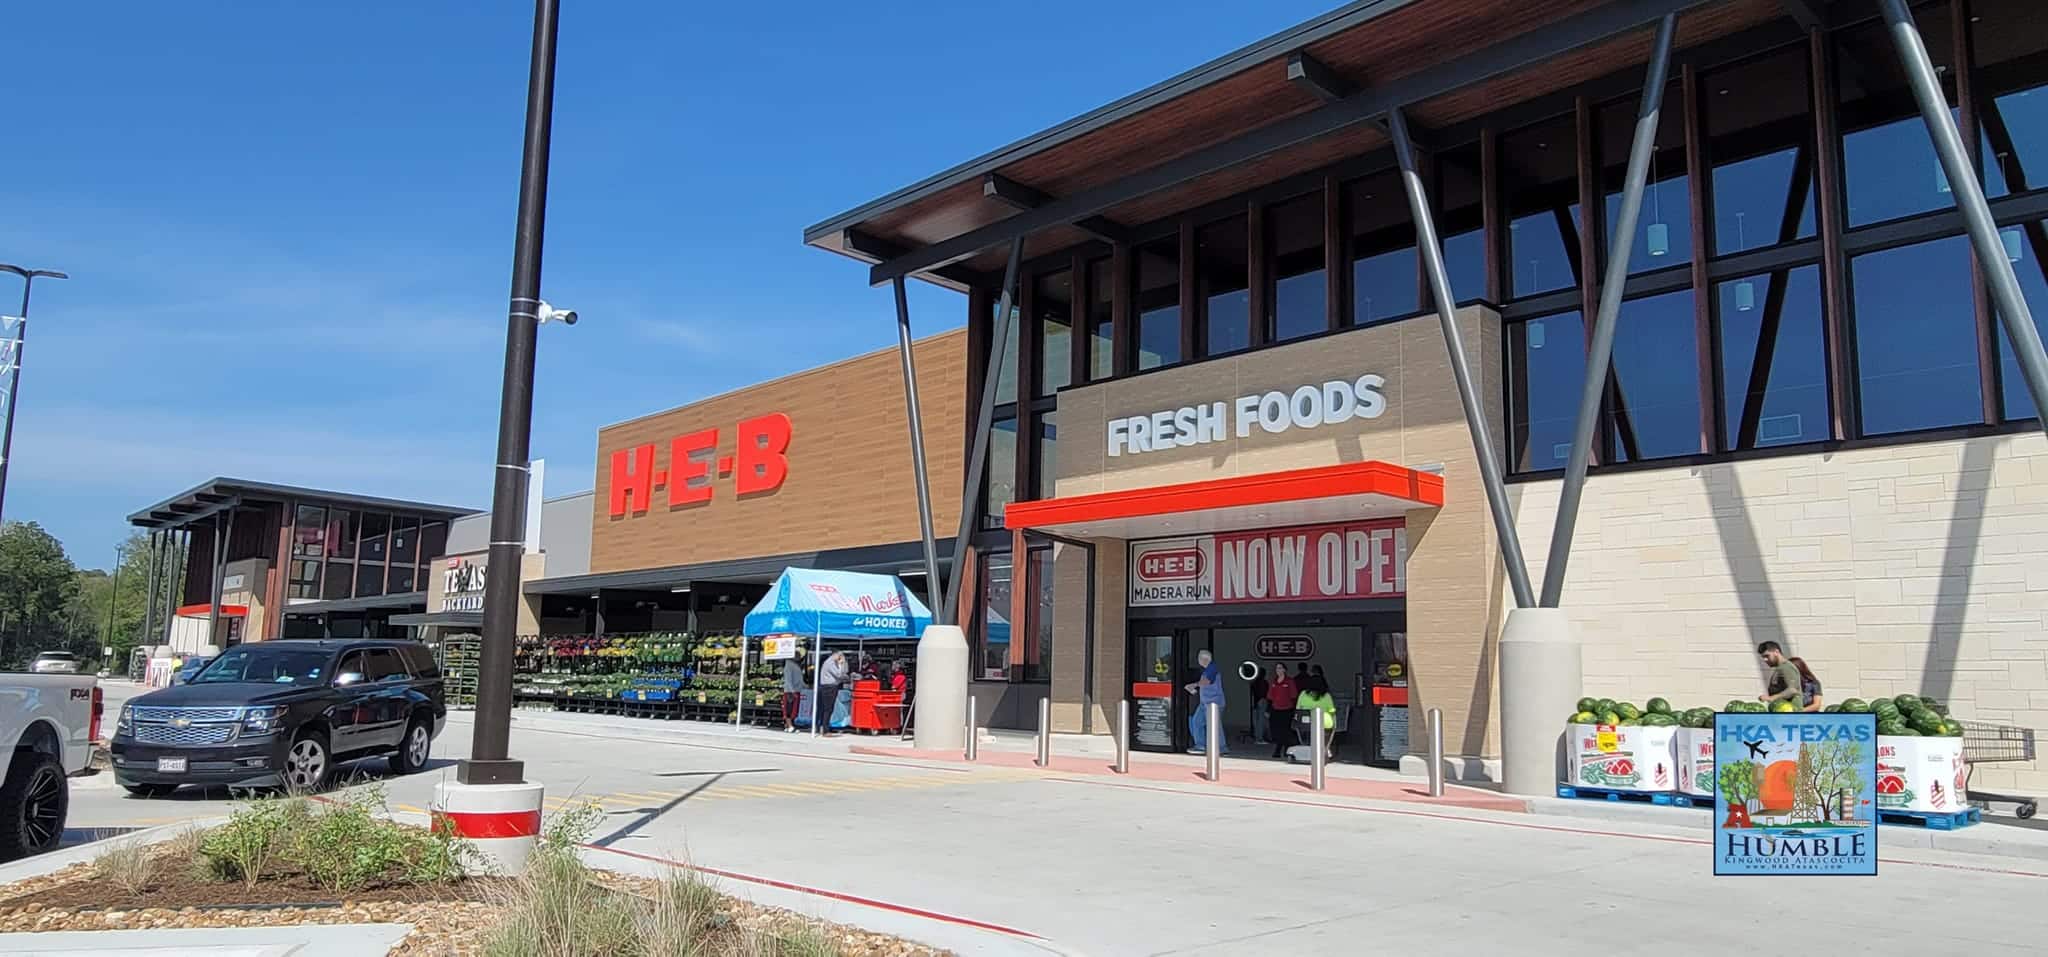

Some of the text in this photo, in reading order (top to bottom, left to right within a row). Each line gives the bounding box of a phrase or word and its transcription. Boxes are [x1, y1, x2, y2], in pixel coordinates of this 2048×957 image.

[1108, 374, 1386, 457] FRESH FOODS
[1222, 535, 1306, 599] NOW
[443, 566, 487, 593] TEXAS
[1134, 583, 1211, 600] MADERA RUN
[442, 597, 484, 611] BACKYARD
[864, 616, 908, 629] HOOKED
